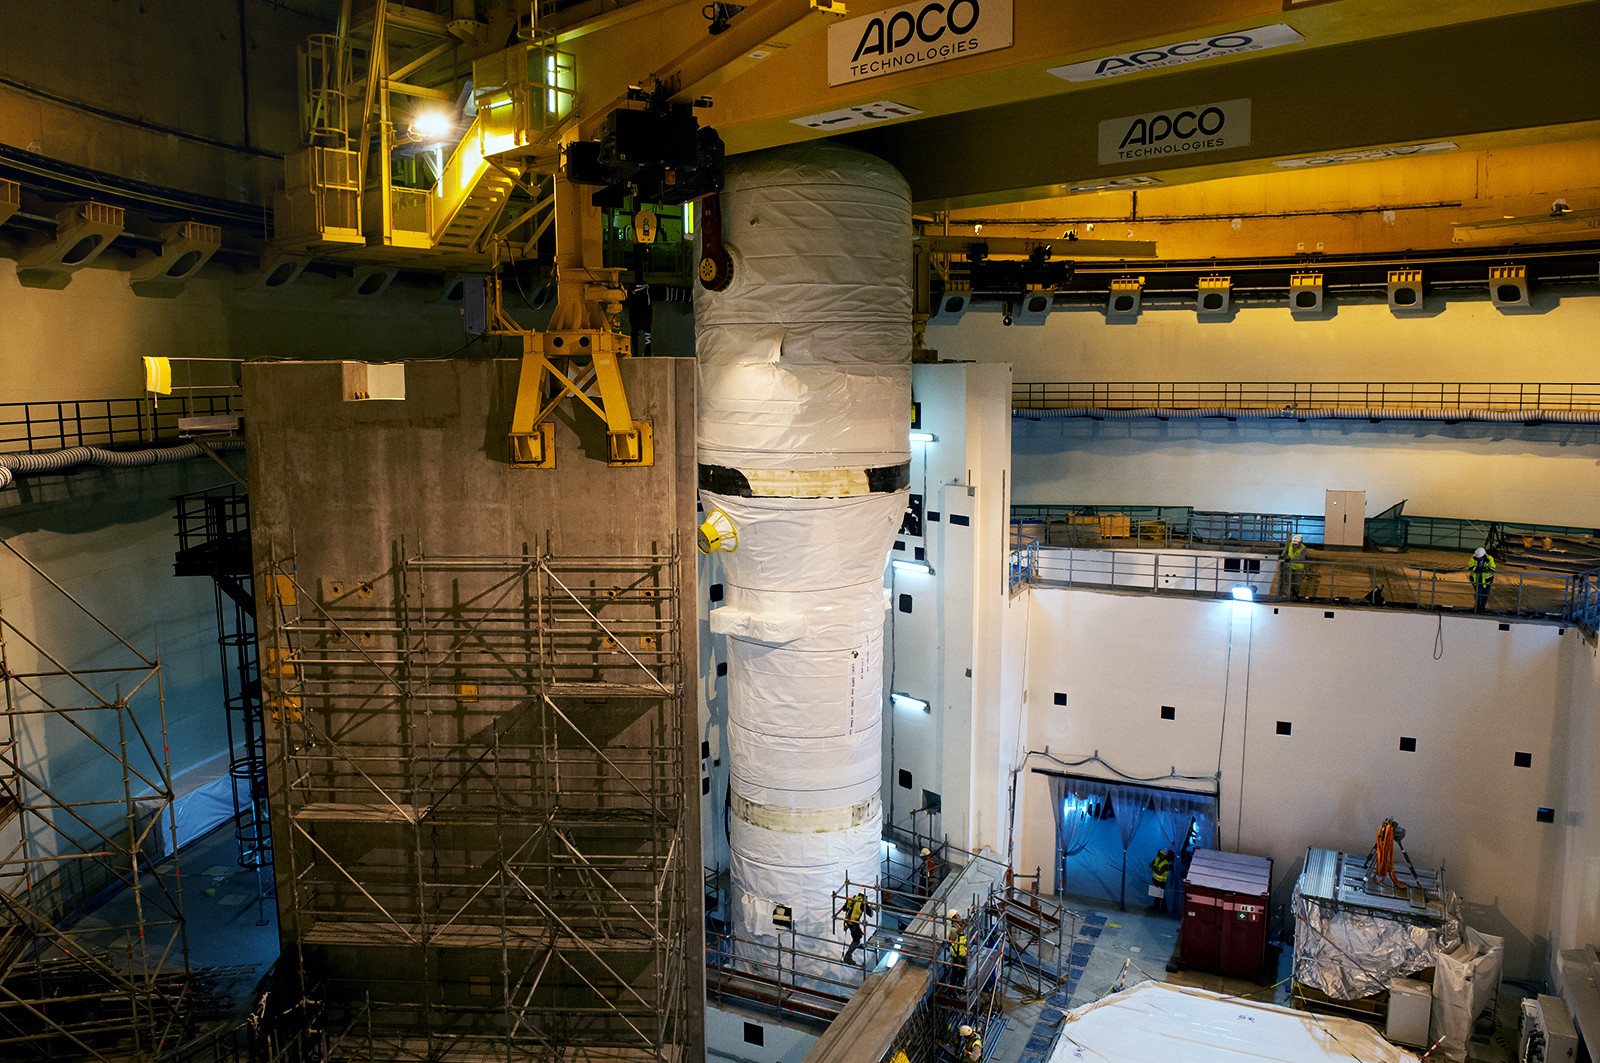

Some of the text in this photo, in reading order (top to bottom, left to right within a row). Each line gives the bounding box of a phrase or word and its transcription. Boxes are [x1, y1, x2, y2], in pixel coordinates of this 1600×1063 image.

[851, 0, 980, 62] APCO
[850, 38, 979, 77] TECHNOLOGIES
[1094, 35, 1253, 75] APCO
[1097, 44, 1263, 78] TECHNOLOGIES
[1118, 106, 1225, 150] APCO
[1118, 137, 1225, 159] TECHNOLOGIES
